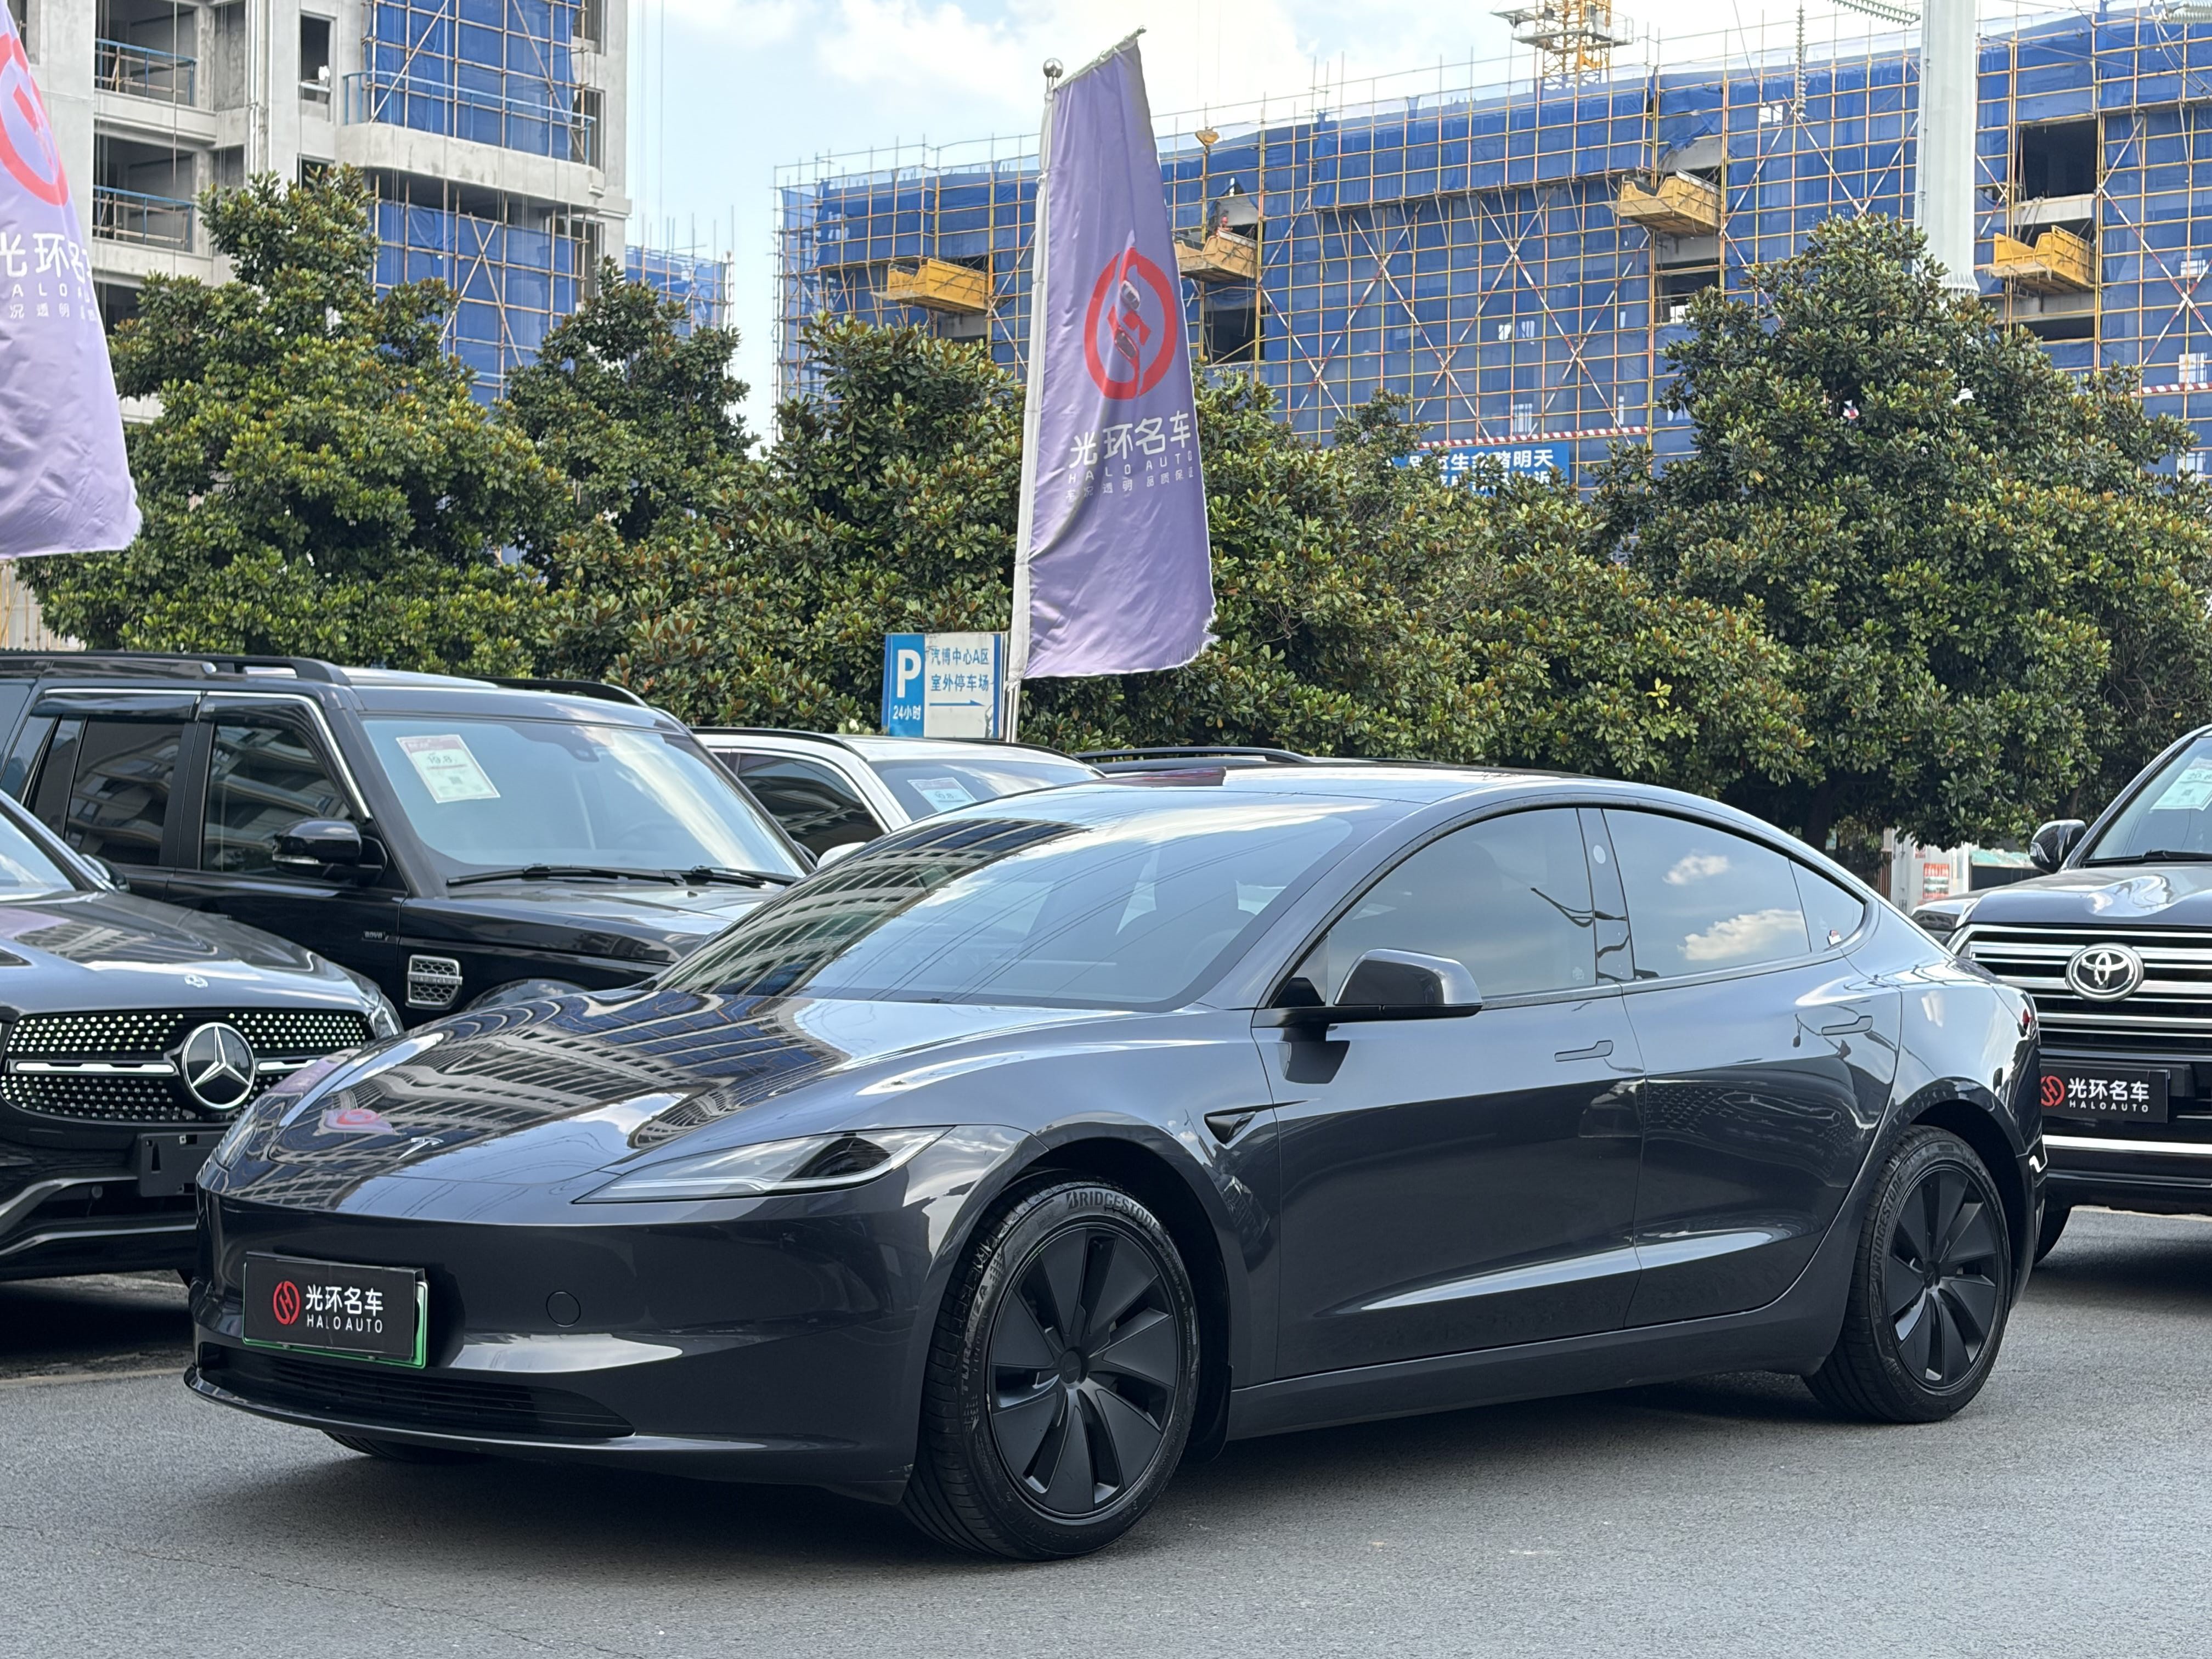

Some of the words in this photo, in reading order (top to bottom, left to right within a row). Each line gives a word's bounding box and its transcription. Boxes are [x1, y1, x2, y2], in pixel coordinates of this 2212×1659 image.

[1069, 410, 1191, 469] 光环名车
[930, 647, 989, 666] 汽博中心A区
[896, 649, 922, 698] P
[930, 674, 989, 692] 室外停车场
[893, 705, 922, 721] 24小时
[2068, 1077, 2149, 1102] 光环名车
[2069, 1100, 2149, 1113] HALOAUTO
[305, 1283, 384, 1317] 光环名车
